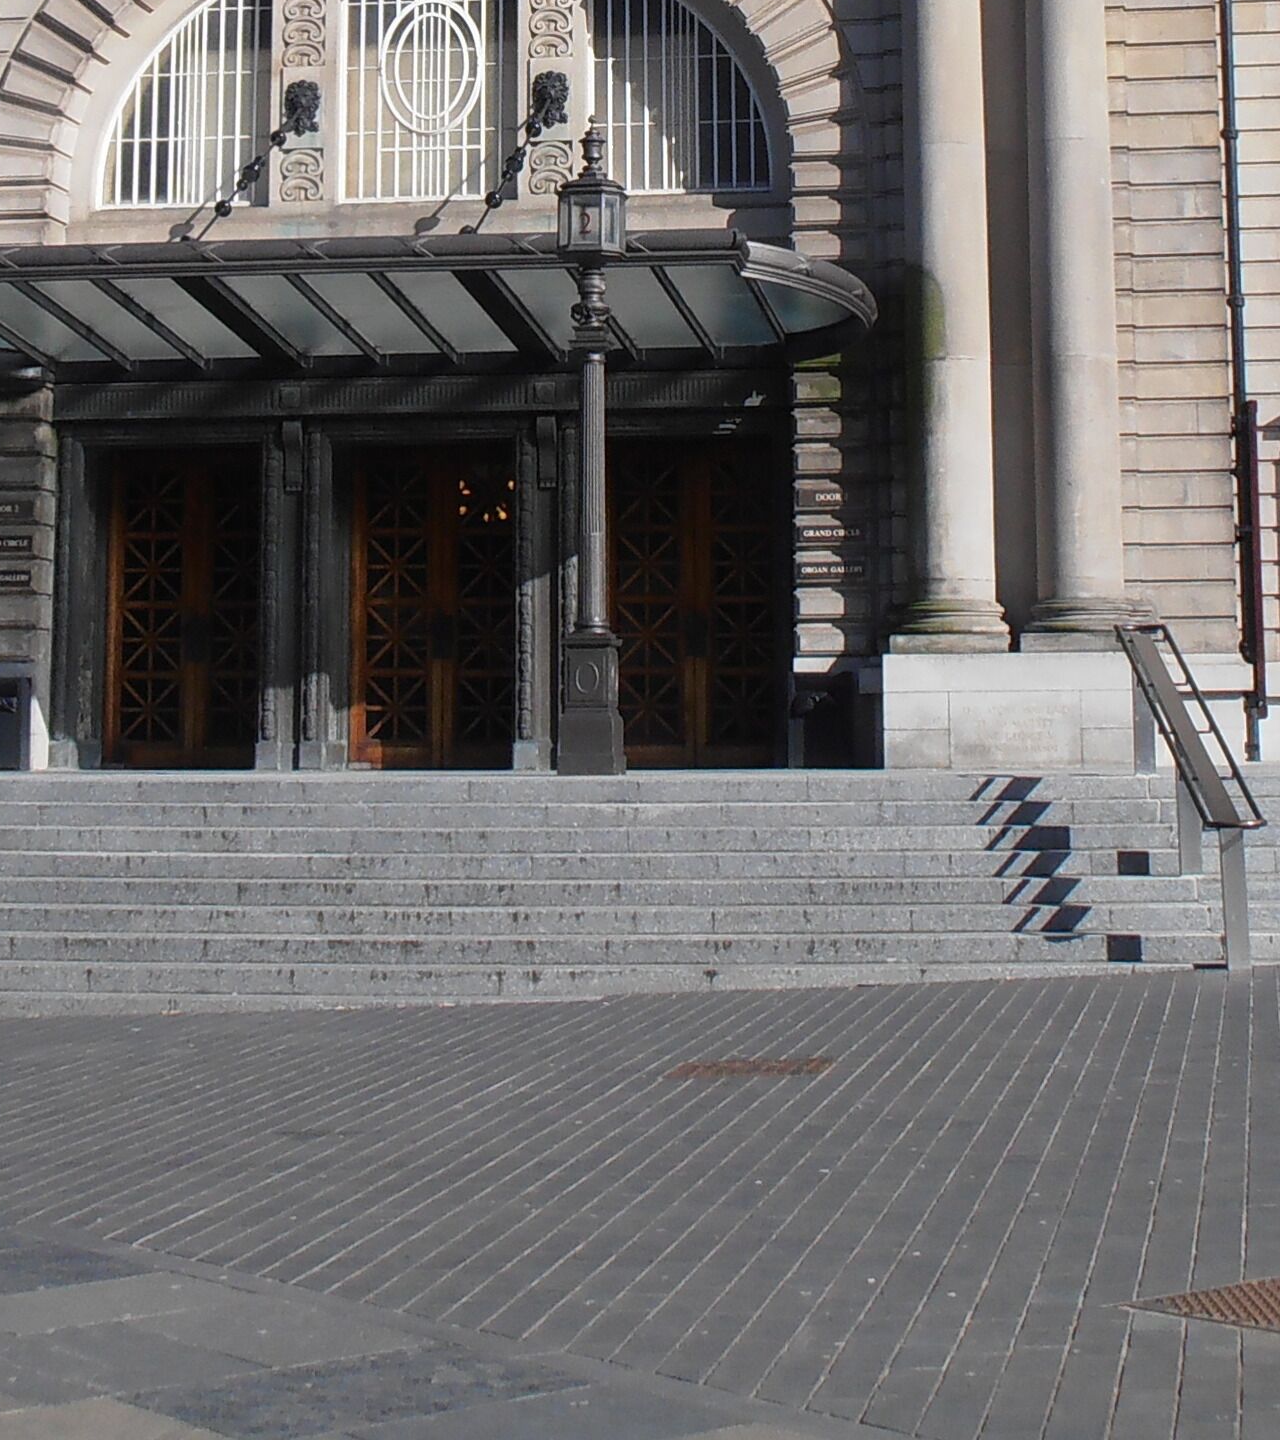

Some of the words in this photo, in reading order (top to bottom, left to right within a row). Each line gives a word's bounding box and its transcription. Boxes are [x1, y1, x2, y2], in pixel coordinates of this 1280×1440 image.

[815, 493, 842, 501] DOOR
[803, 529, 832, 537] GRAND
[833, 528, 860, 536] CIRCLE
[3, 539, 28, 547] CIRCLE
[801, 566, 828, 574] ORGAN
[830, 566, 862, 574] GALLERY
